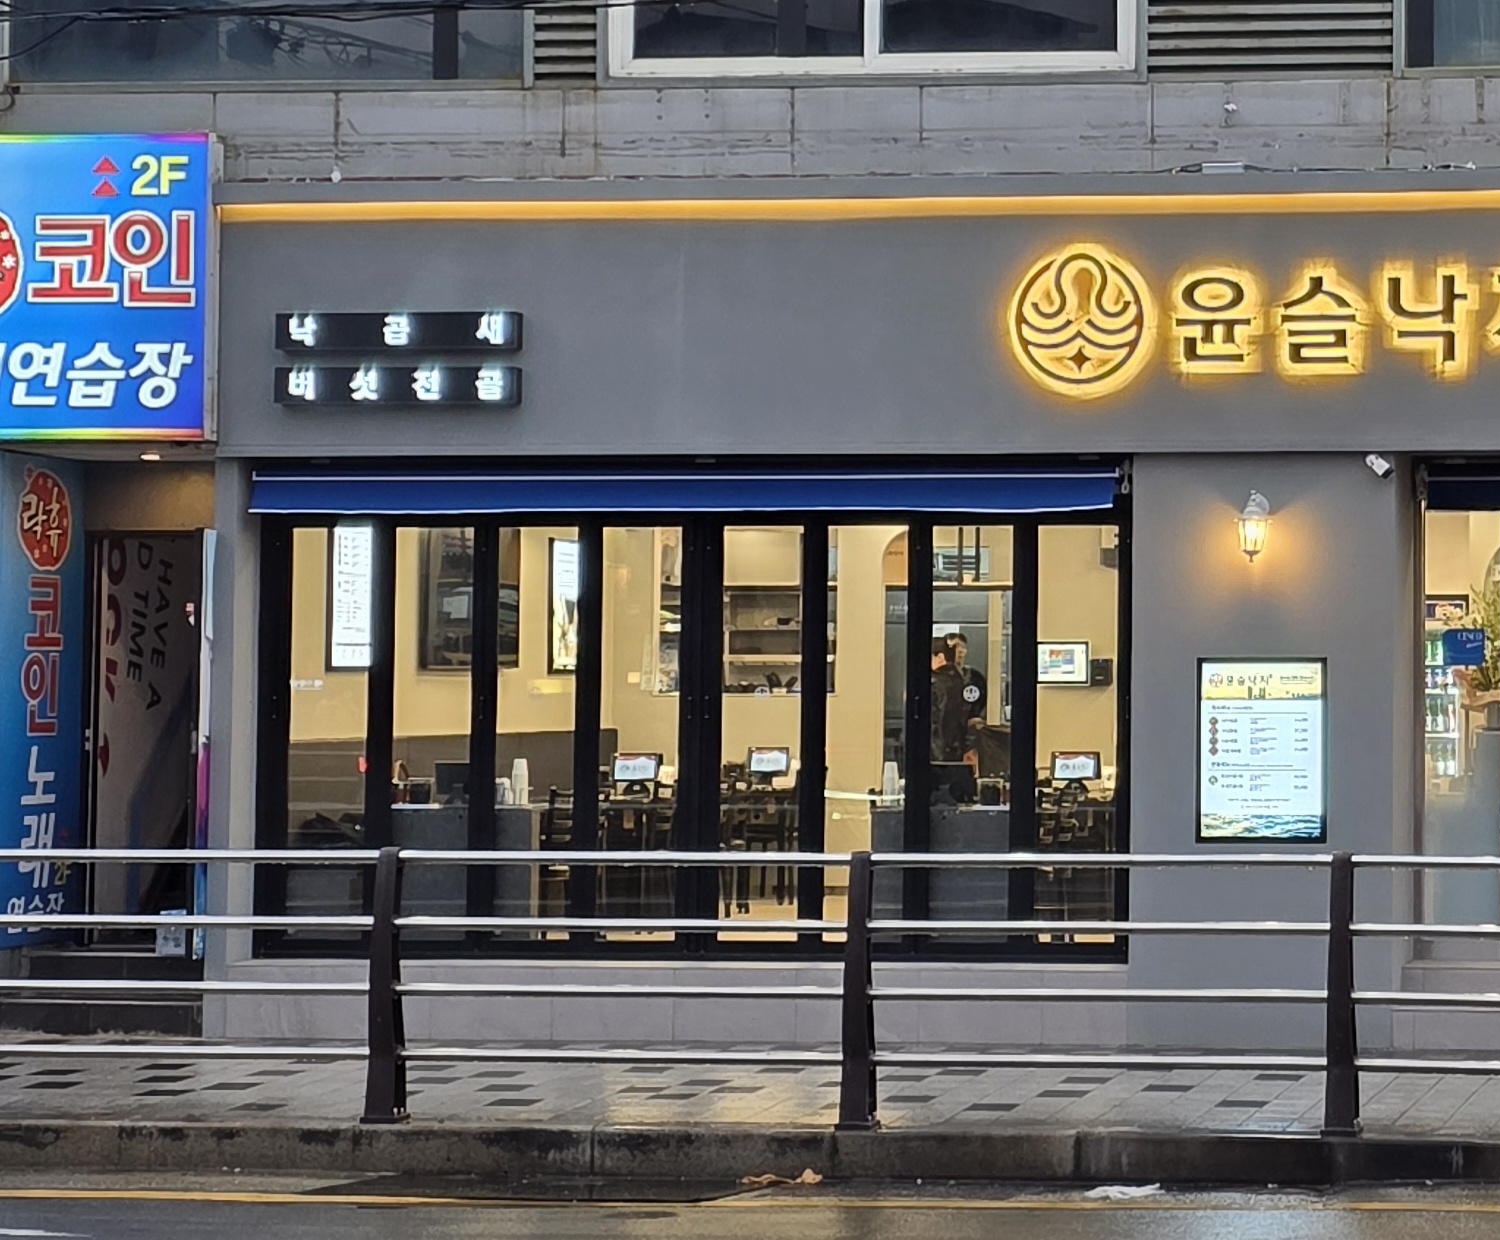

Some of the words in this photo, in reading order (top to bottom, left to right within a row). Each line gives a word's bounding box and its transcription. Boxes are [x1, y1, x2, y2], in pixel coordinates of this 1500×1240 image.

[130, 155, 189, 196] 2F
[27, 210, 196, 308] 코인
[0, 342, 194, 408] 연습장
[288, 364, 504, 401] 버섯전골
[21, 574, 64, 737] 코인
[126, 590, 149, 683] TIME
[150, 559, 174, 670] HAVE
